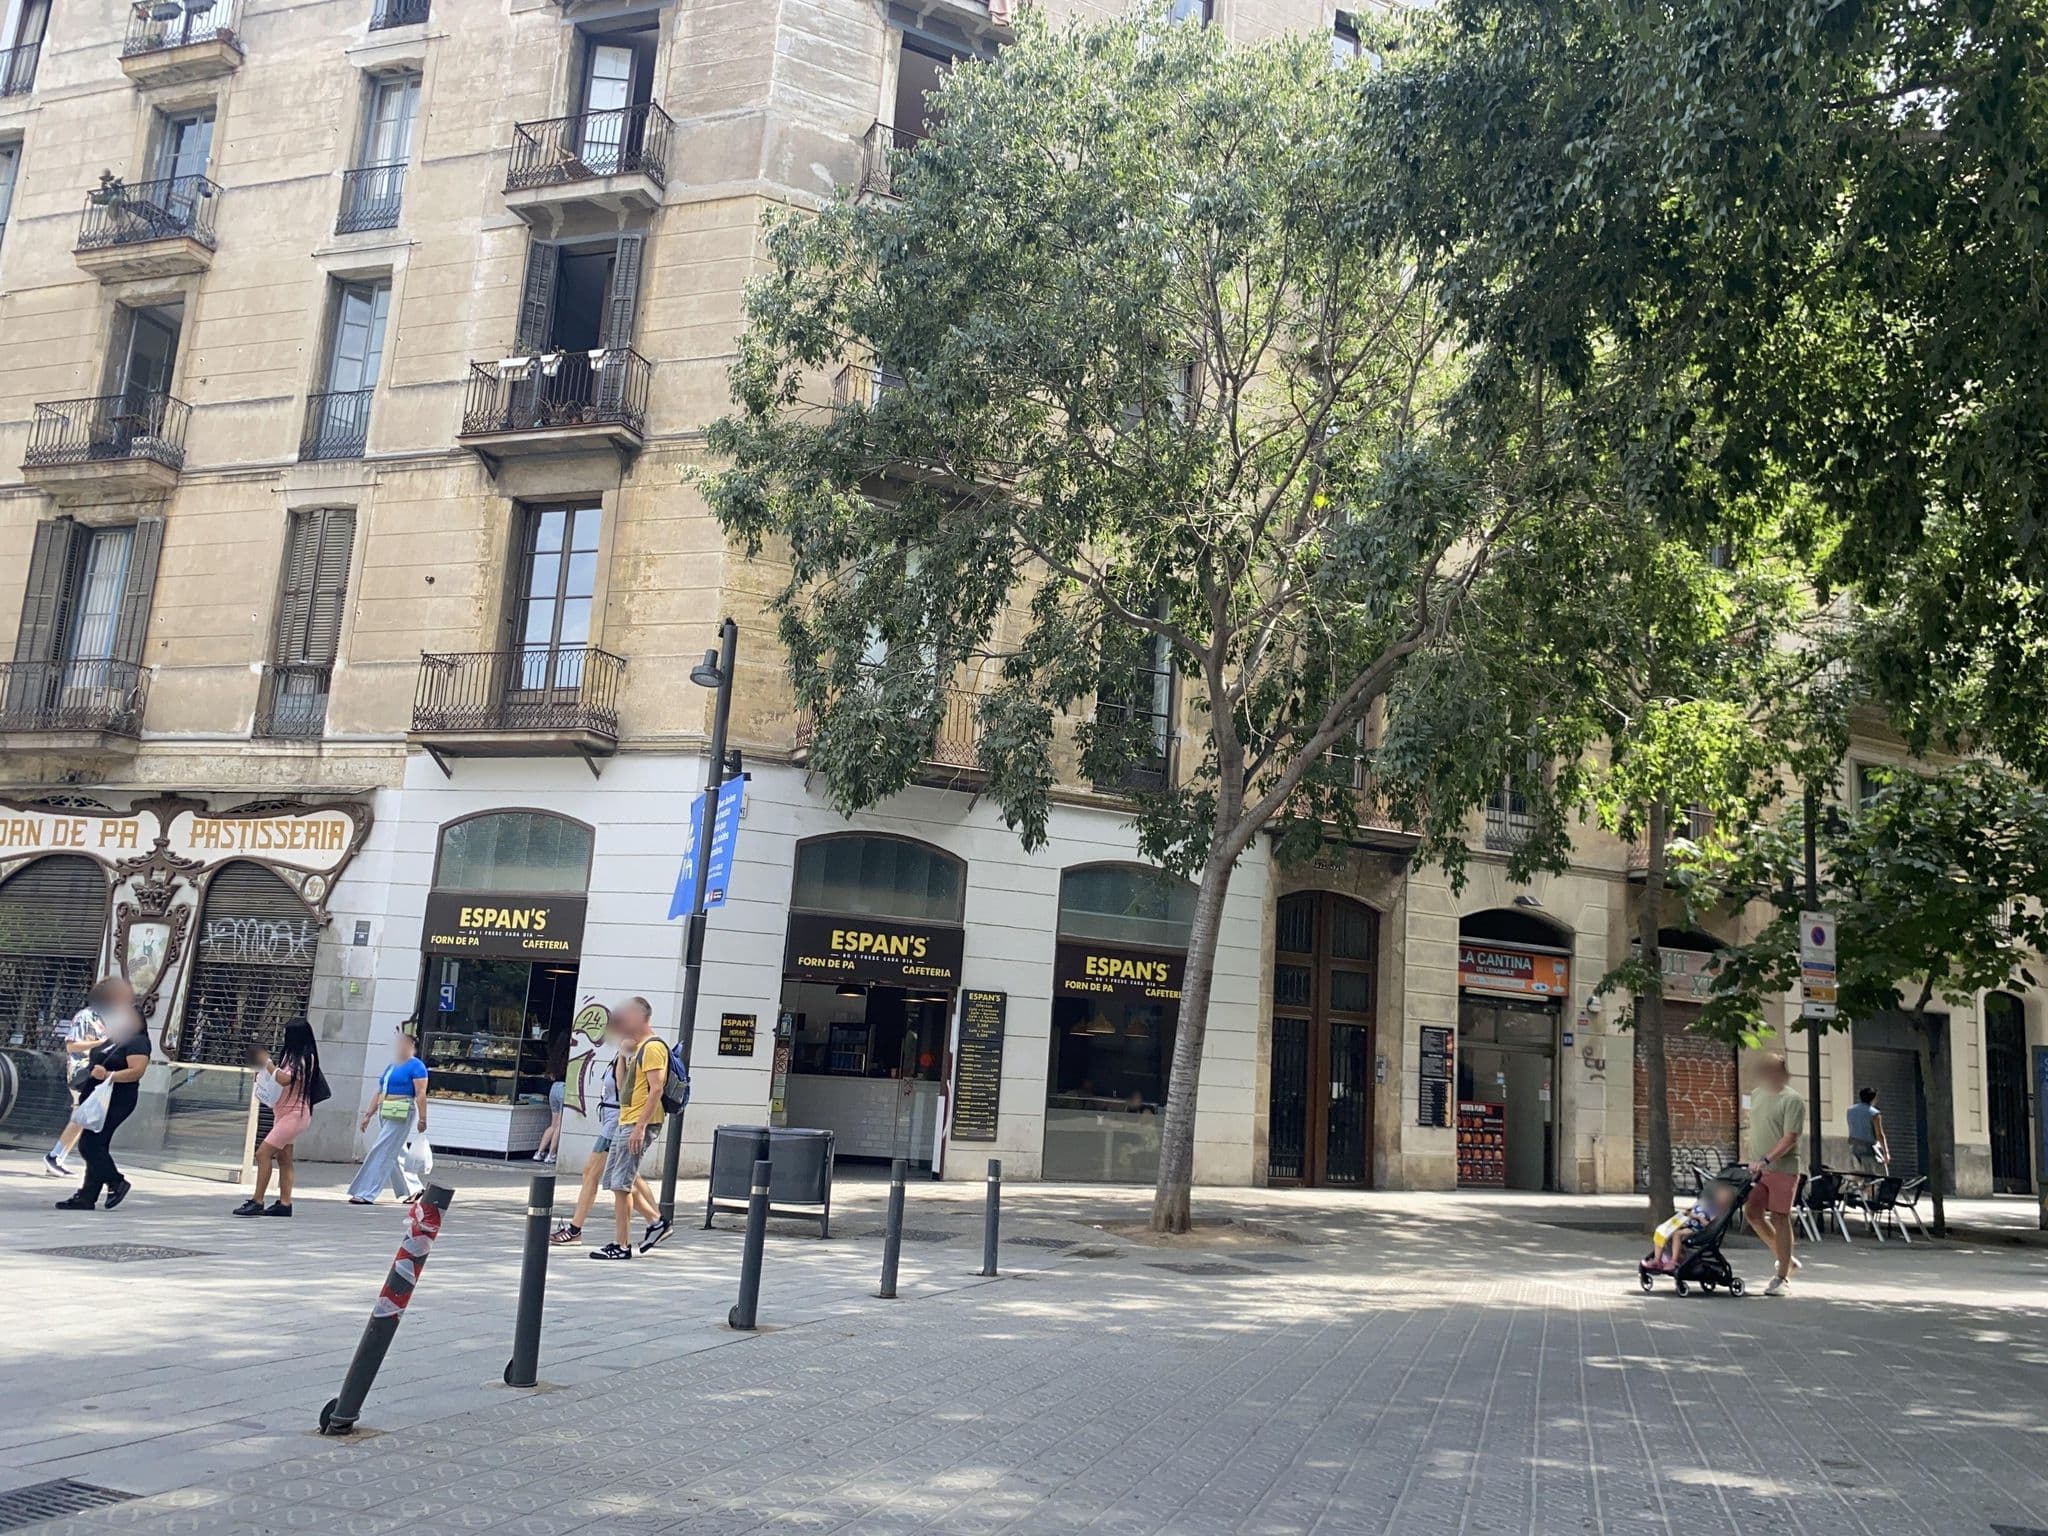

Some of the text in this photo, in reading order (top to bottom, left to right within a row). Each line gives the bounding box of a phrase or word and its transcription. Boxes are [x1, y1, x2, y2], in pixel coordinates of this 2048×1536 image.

[50, 819, 88, 847] DE
[97, 820, 139, 849] PA
[188, 820, 345, 850] PASTISSERIA
[459, 907, 547, 931] ESPAN'S
[430, 935, 480, 946] FORN DE PA
[522, 939, 569, 950] CAFETERIA
[831, 929, 927, 957] ESPAN'S
[798, 957, 855, 970] FORN DE PA
[1477, 952, 1532, 970] CANTINA
[902, 966, 951, 978] CAFETERIA
[1086, 956, 1168, 982] ESPAN'S
[1064, 980, 1114, 993] FORN DE PA
[968, 992, 1001, 1002] ESPAN'S
[1145, 988, 1182, 999] CAFETERI
[722, 1018, 755, 1028] ESPAN'S
